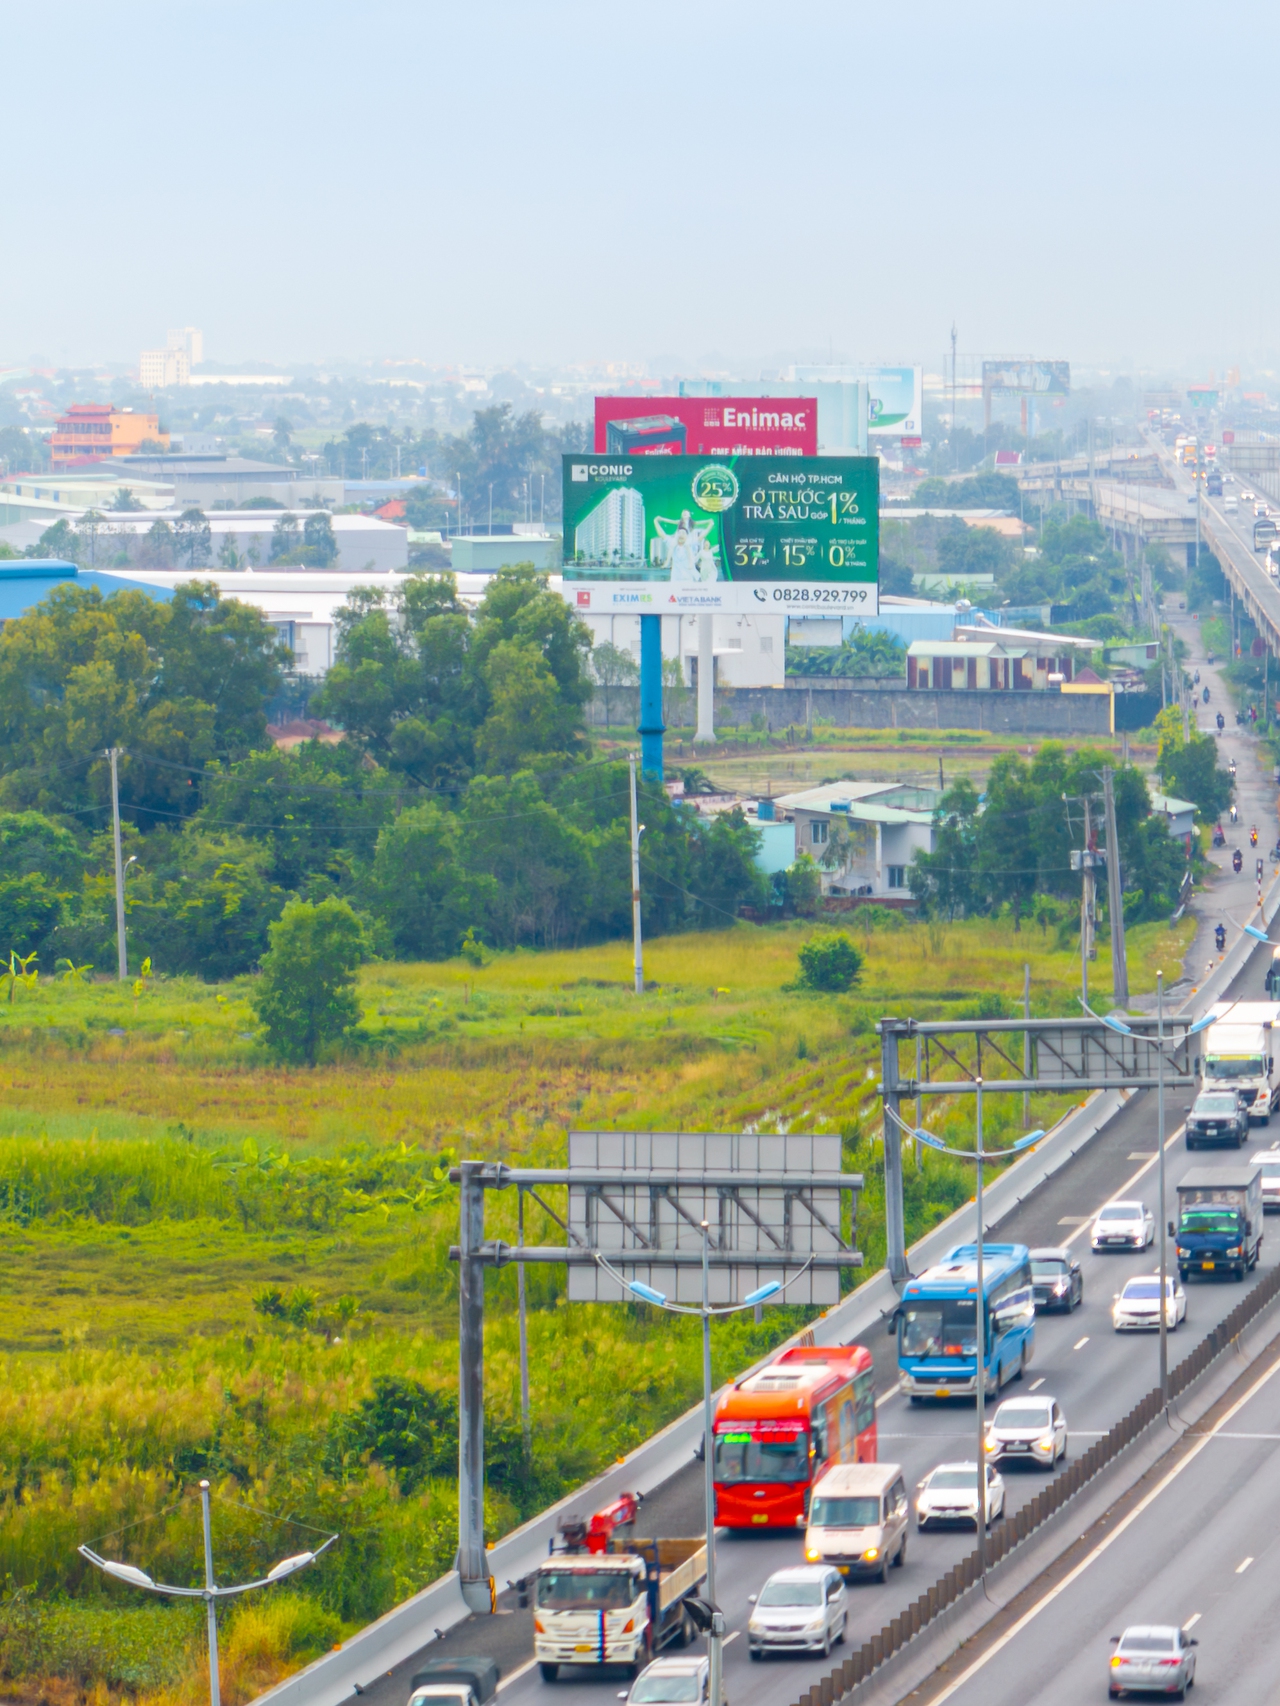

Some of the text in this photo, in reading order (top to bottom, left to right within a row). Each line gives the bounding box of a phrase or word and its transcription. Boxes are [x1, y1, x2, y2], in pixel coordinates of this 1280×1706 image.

[723, 408, 805, 427] Enimac
[589, 465, 633, 475] CONIC
[768, 473, 842, 485] CĂN HỘ TP.HCM
[701, 482, 732, 496] 25%
[752, 487, 825, 504] Ở TRƯỚC
[743, 503, 774, 519] TRẢ
[778, 506, 808, 519] SAU
[827, 492, 858, 525] 1%
[782, 545, 815, 566] 15%
[829, 545, 856, 566] 0%
[773, 589, 867, 602] 0828.929.799
